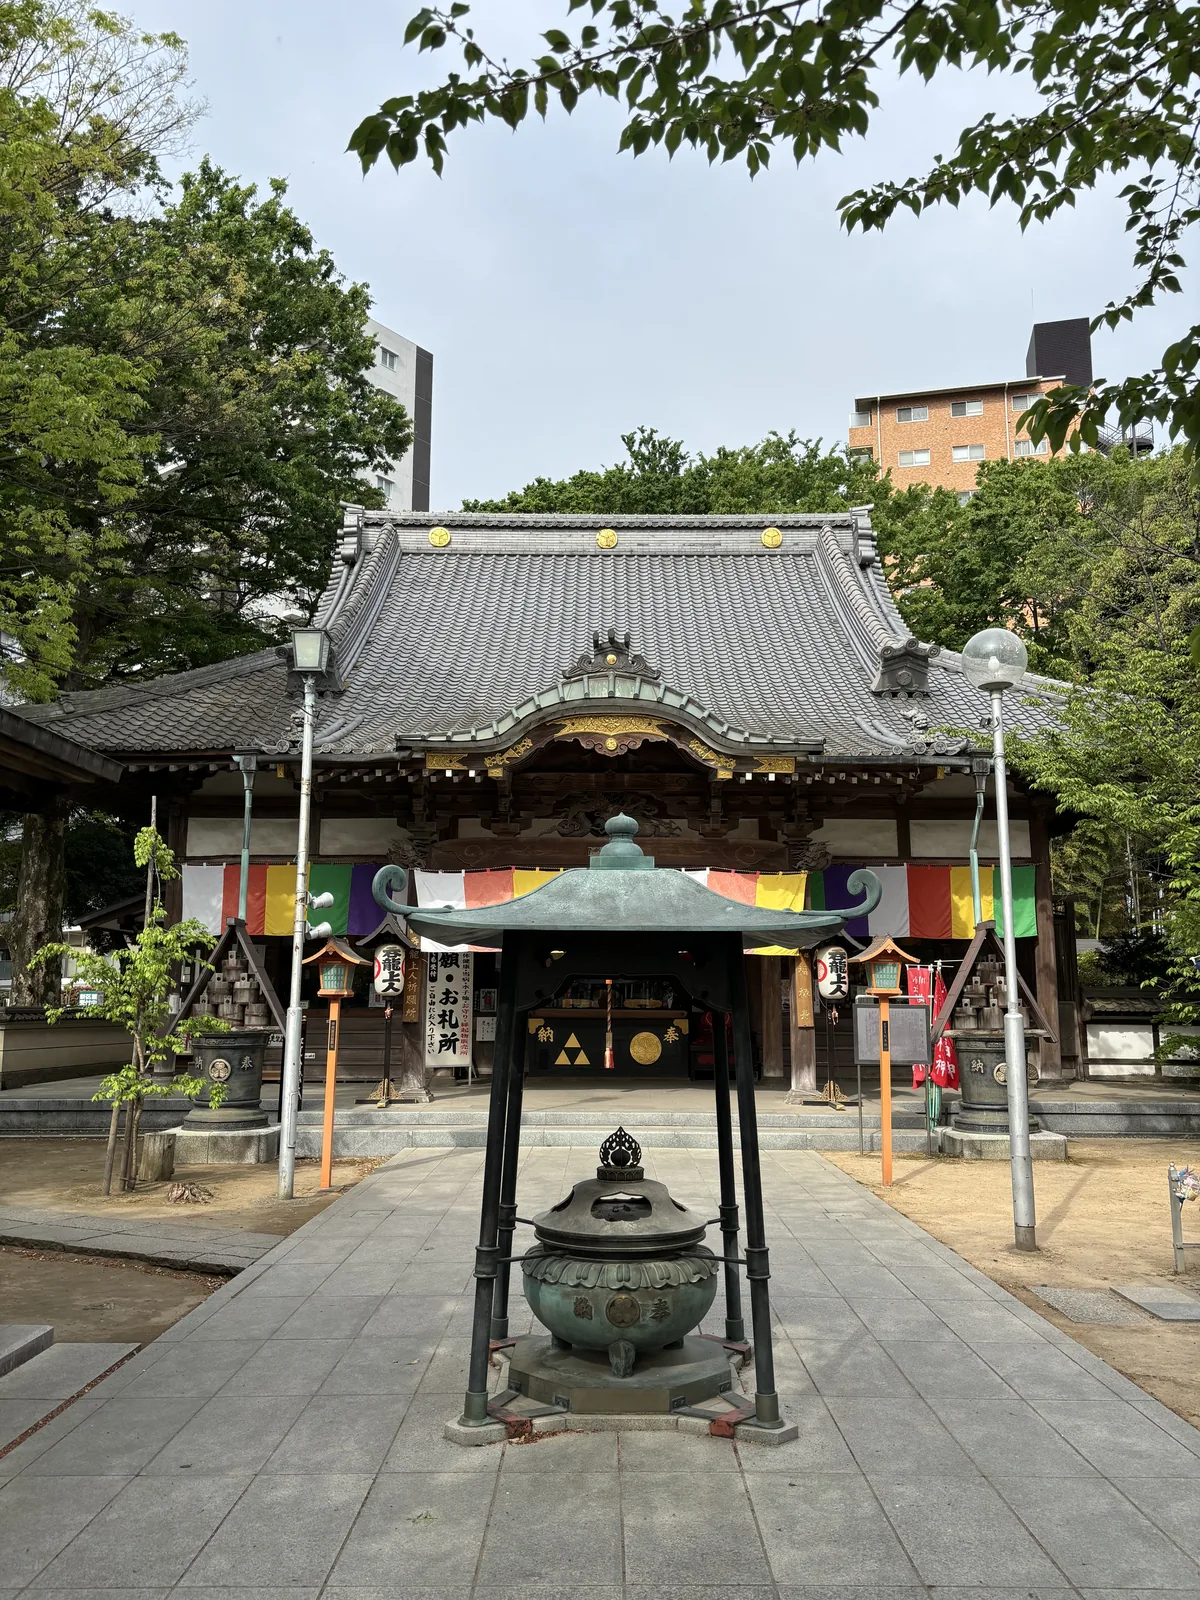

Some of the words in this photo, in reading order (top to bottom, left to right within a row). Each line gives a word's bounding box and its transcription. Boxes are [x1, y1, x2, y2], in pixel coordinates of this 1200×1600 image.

[381, 948, 402, 993] 呑龍上人
[827, 949, 848, 996] 呑龍上人
[427, 985, 437, 1055] ご自由にお入り下さい
[537, 1027, 554, 1043] 納
[663, 1026, 679, 1044] 奉
[240, 1055, 254, 1071] 奉
[971, 1059, 984, 1074] 納
[649, 1299, 671, 1321] 奉
